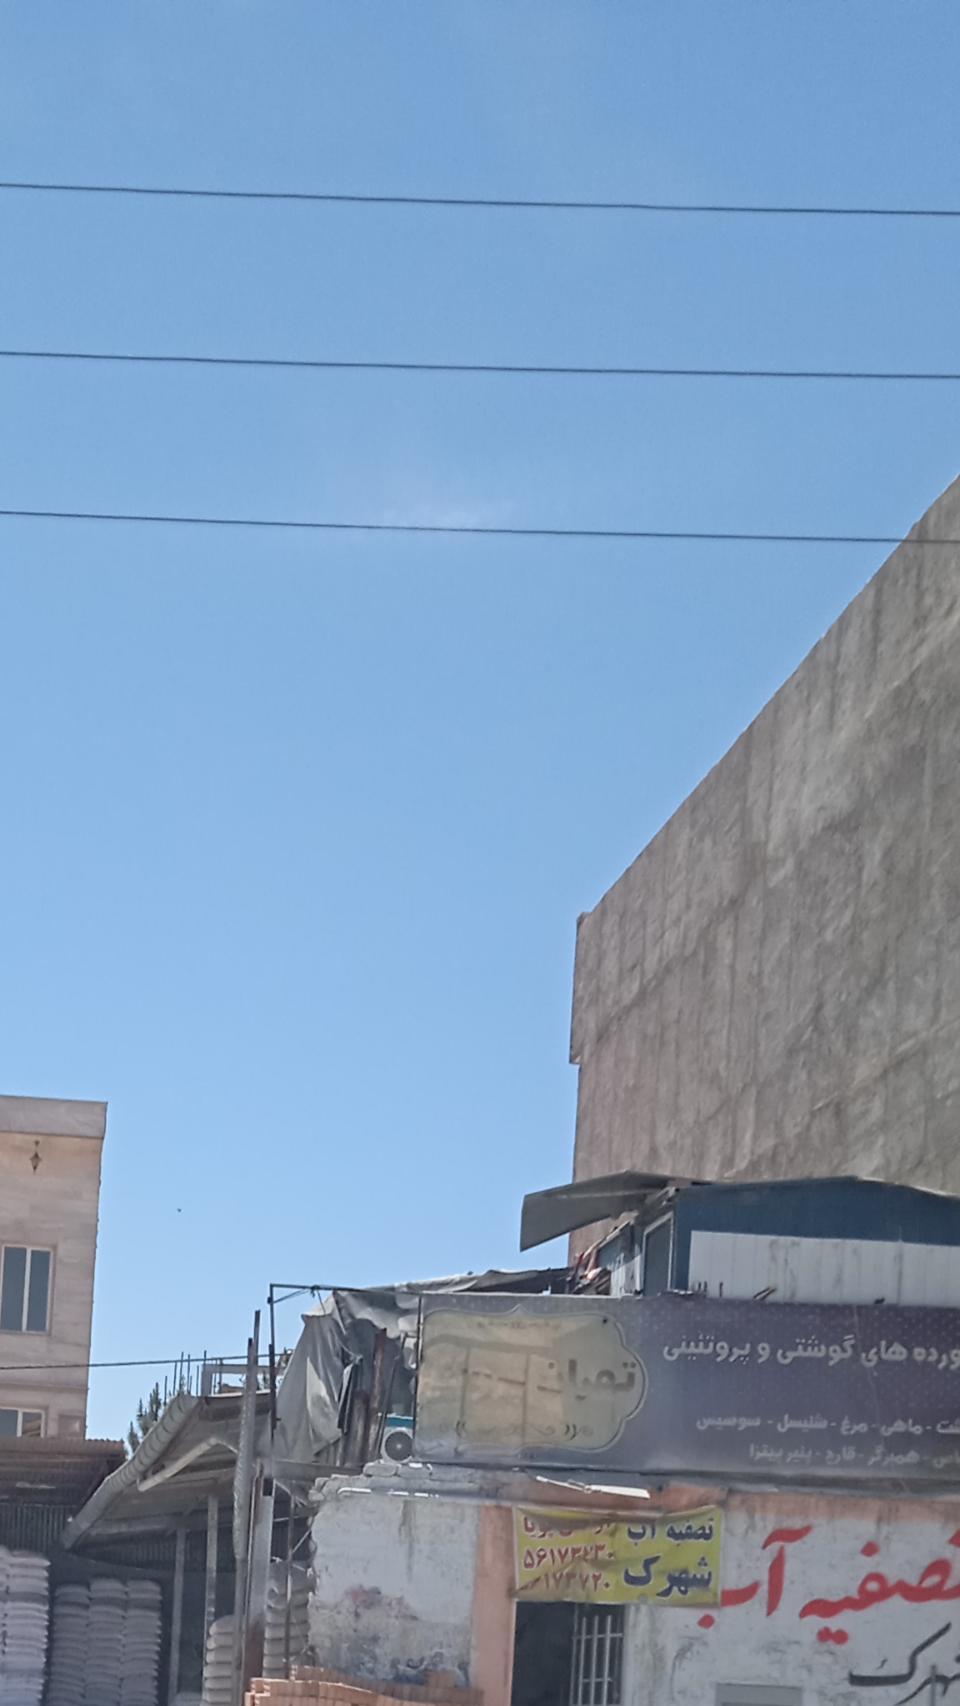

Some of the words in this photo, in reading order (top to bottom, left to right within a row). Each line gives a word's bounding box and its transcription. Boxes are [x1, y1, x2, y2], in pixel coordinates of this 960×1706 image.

[662, 1335, 751, 1365] پروتئینی
[757, 1341, 770, 1362] و
[777, 1335, 855, 1366] گوشتی
[861, 1340, 907, 1367] های
[696, 1415, 761, 1431] سوسیس
[840, 1414, 869, 1435] مرغ
[666, 1518, 714, 1546] تصفیه
[623, 1556, 712, 1598] شهرک
[697, 1525, 813, 1629] آب
